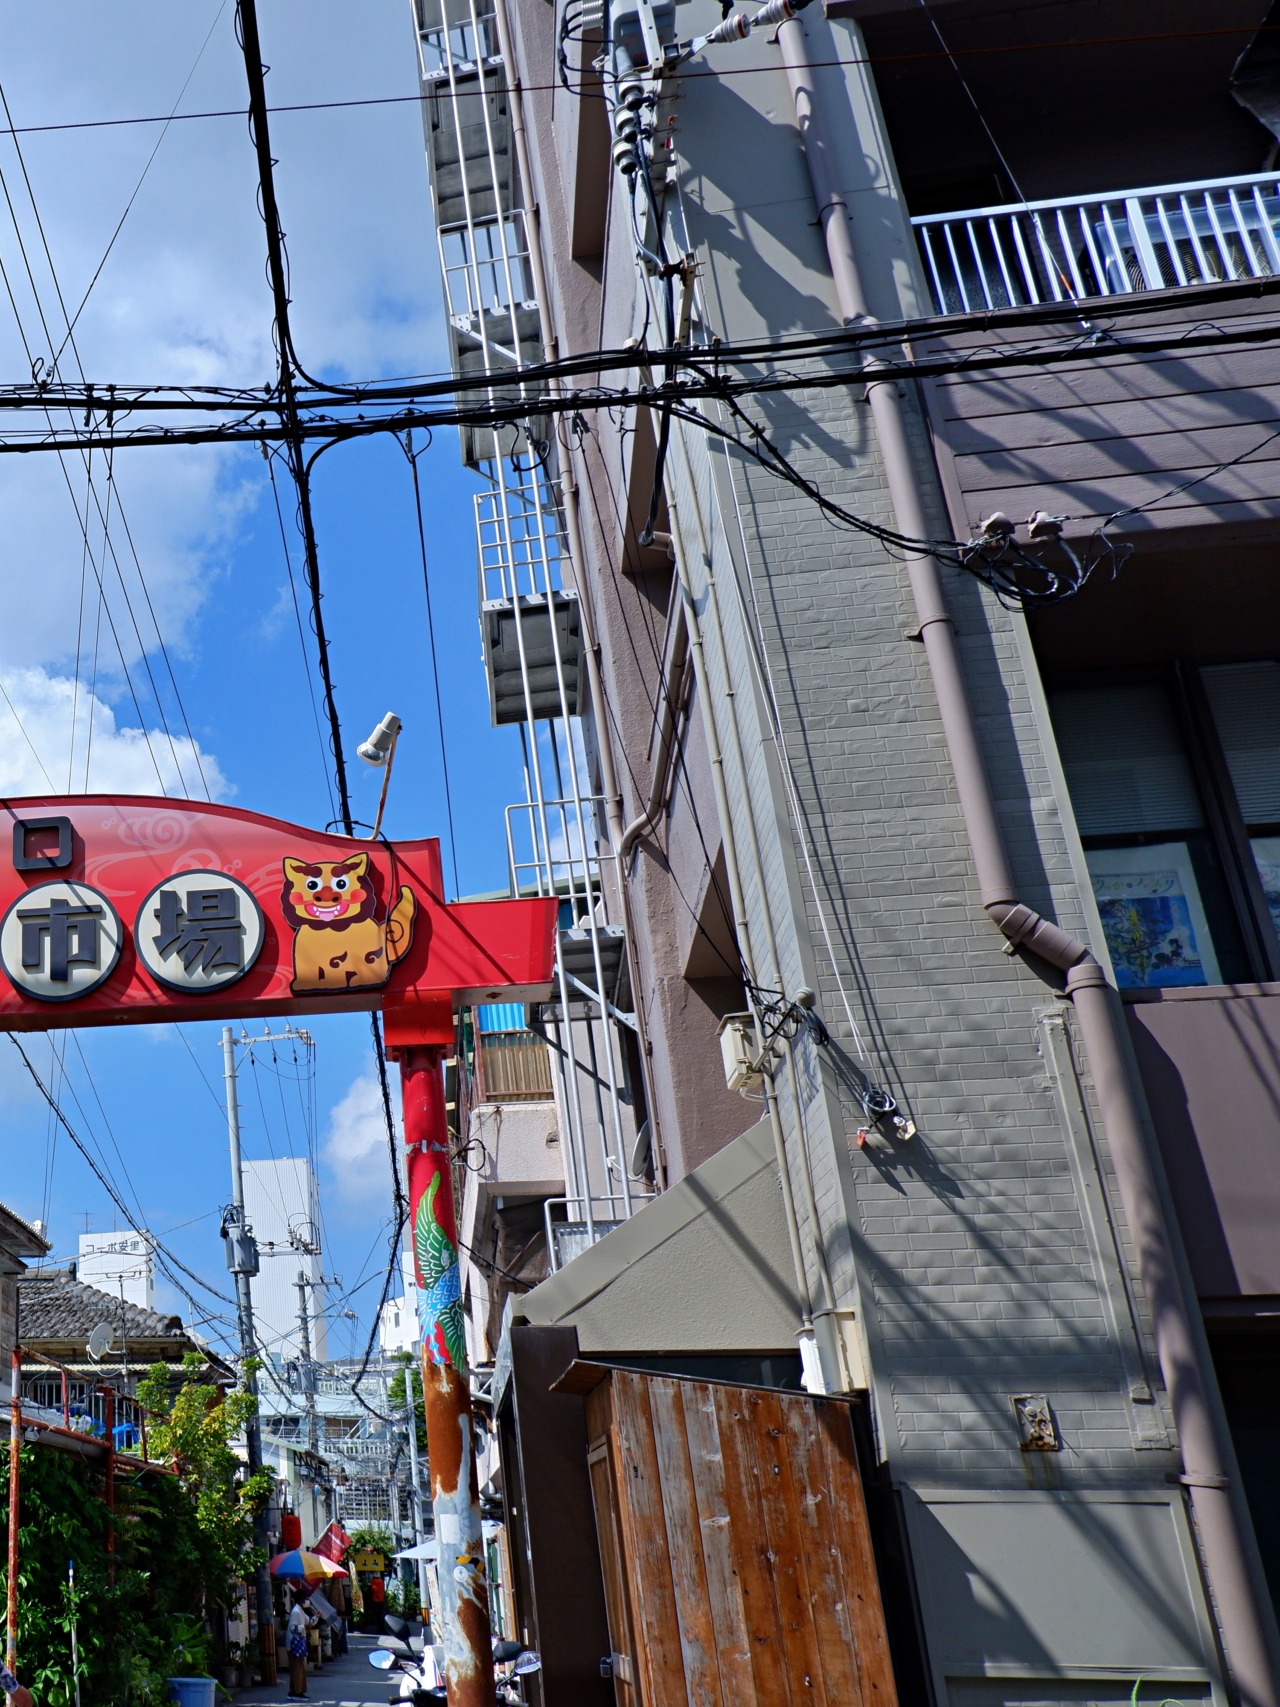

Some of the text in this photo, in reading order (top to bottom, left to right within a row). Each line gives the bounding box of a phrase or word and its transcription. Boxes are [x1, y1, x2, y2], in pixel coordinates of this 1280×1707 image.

[85, 1240, 140, 1254] コーポ安里
